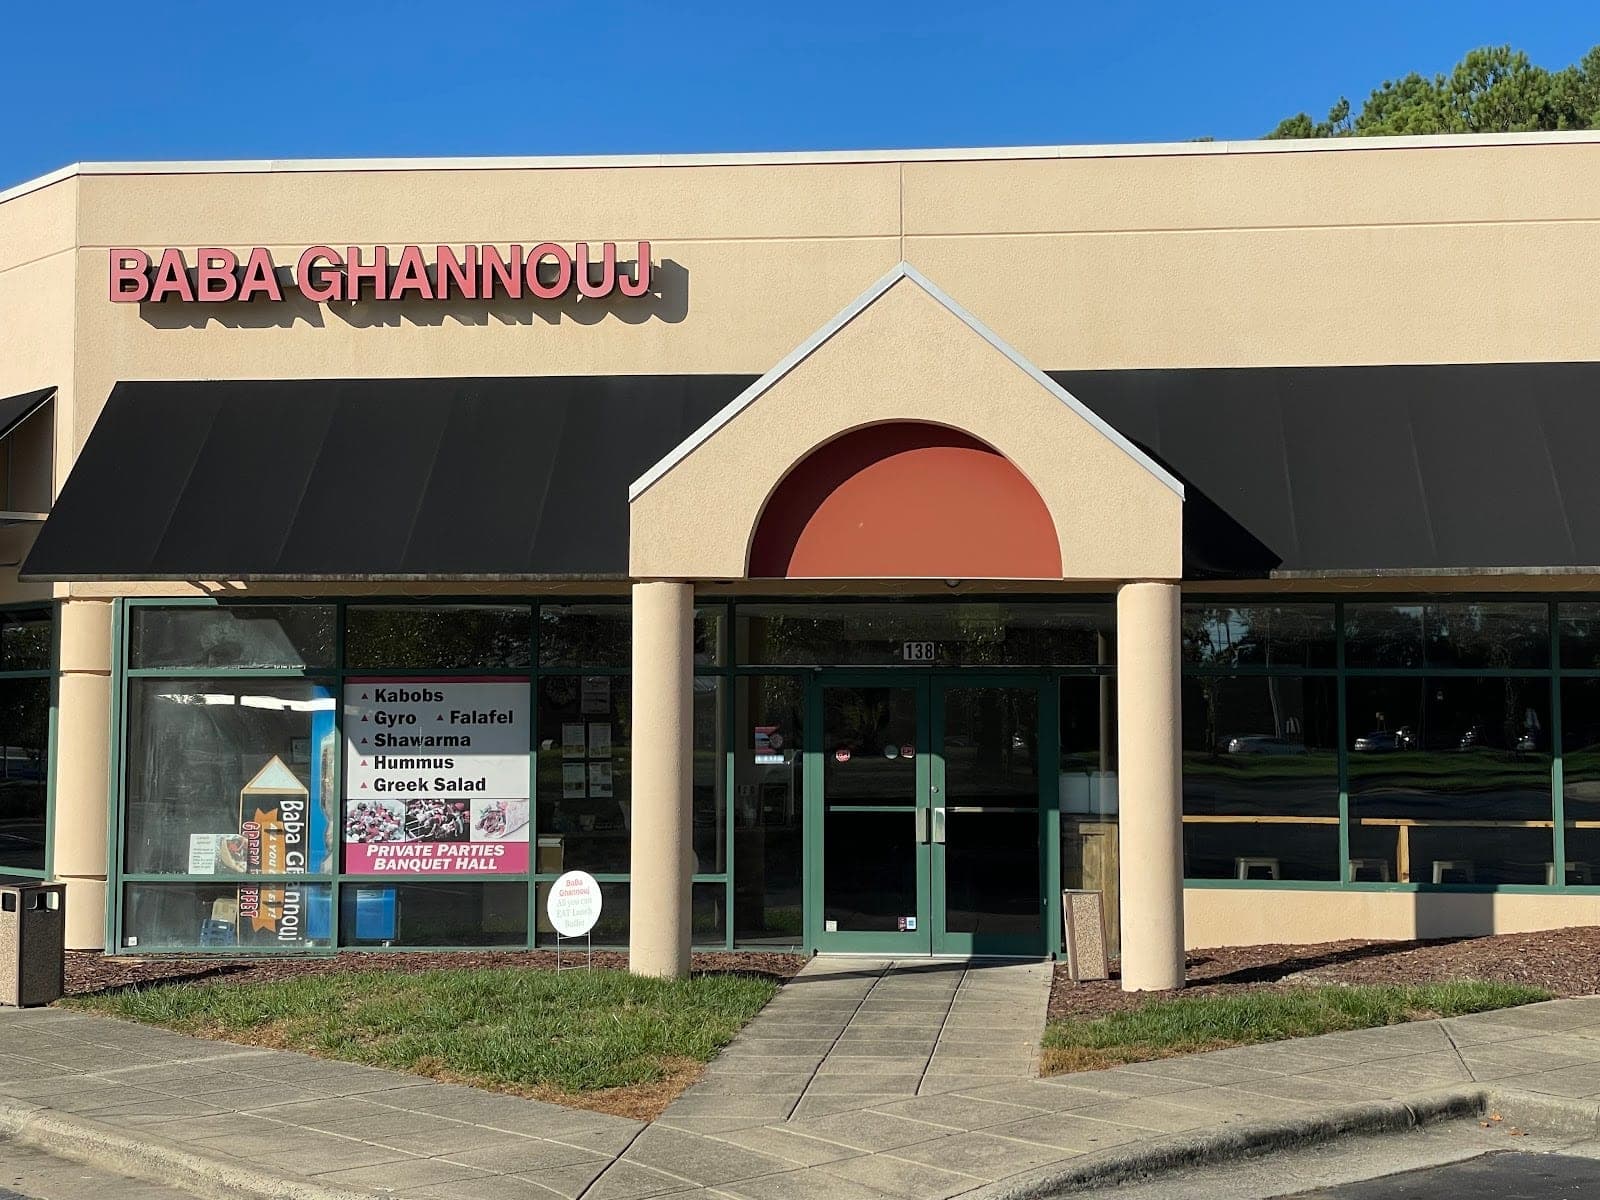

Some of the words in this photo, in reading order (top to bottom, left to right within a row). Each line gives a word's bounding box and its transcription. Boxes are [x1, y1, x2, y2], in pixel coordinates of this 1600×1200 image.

[108, 246, 282, 303] BABA
[297, 241, 652, 303] GHANNOUJ
[905, 643, 933, 659] 138
[374, 688, 444, 703] Kabobs
[374, 711, 417, 728] Gyro
[450, 710, 513, 724] Falafel
[374, 733, 471, 747] Shawarma
[374, 755, 455, 770] Hummus
[373, 777, 429, 792] Greek
[433, 777, 486, 792] Salad
[279, 800, 304, 844] Baba
[366, 844, 437, 857] PRIVATE
[437, 844, 505, 857] PARTIES
[373, 858, 452, 872] BANQUET
[455, 857, 498, 870] HALL
